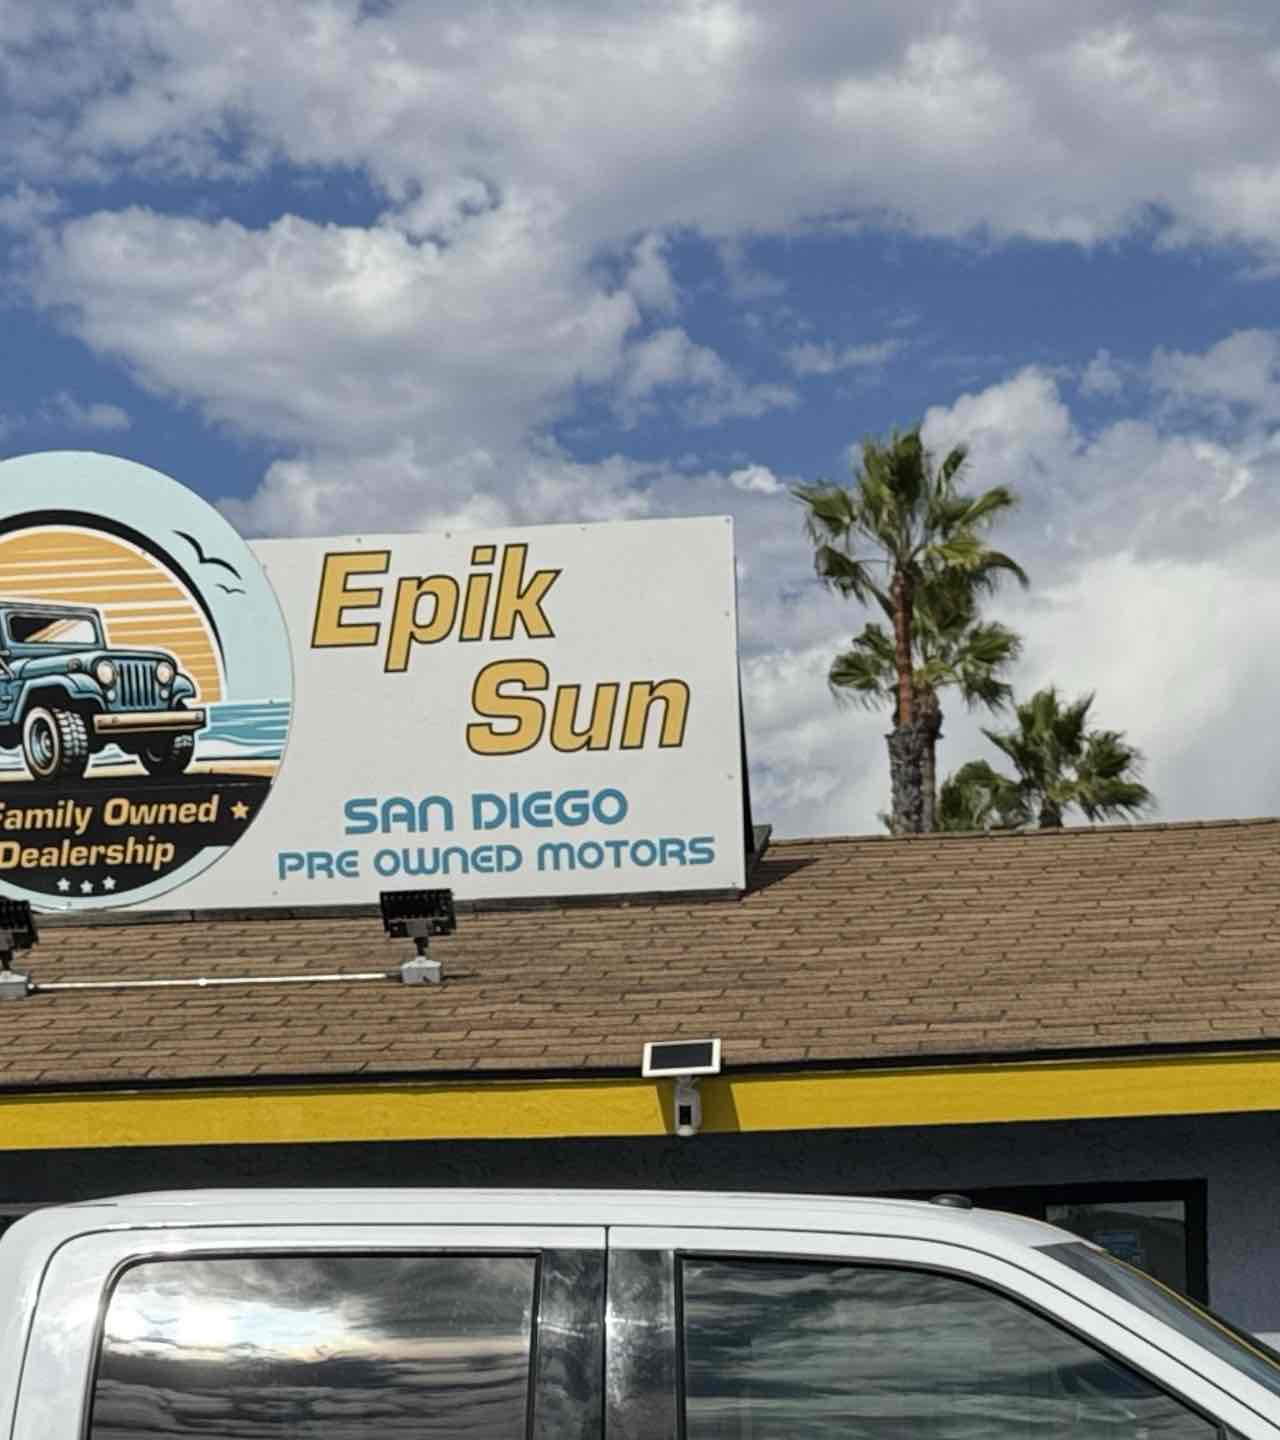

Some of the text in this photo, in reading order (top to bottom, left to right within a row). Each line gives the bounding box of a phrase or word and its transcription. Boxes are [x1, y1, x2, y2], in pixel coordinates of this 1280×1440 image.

[310, 543, 563, 673] Epik
[466, 658, 691, 756] Sun
[103, 794, 219, 827] Owned
[344, 787, 630, 836] SAN DIEGO
[278, 835, 717, 881] PRE OWNED MOTORS
